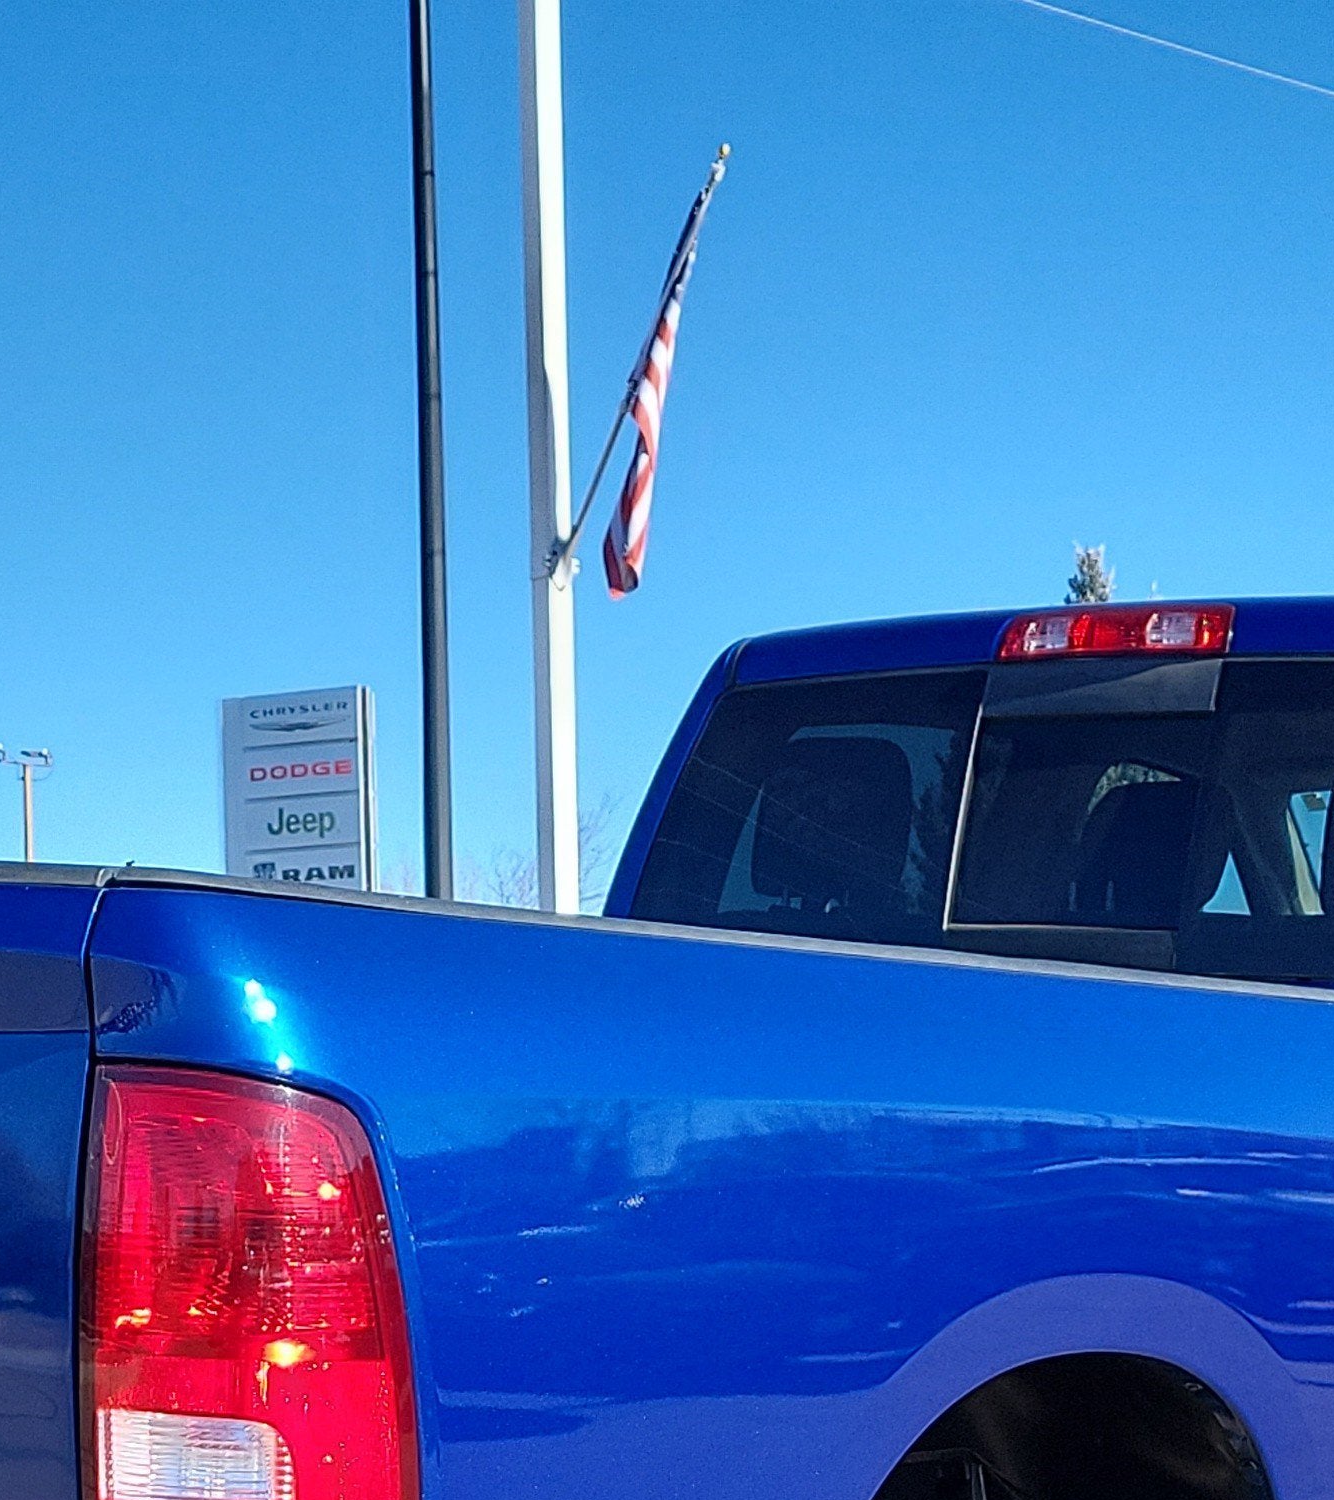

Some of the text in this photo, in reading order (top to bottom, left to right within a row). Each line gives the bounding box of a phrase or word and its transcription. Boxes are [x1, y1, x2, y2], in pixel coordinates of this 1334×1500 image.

[249, 701, 349, 719] CHRYSLER
[250, 759, 352, 782] DODGE
[267, 807, 336, 839] Jeep
[281, 864, 356, 881] RAM
